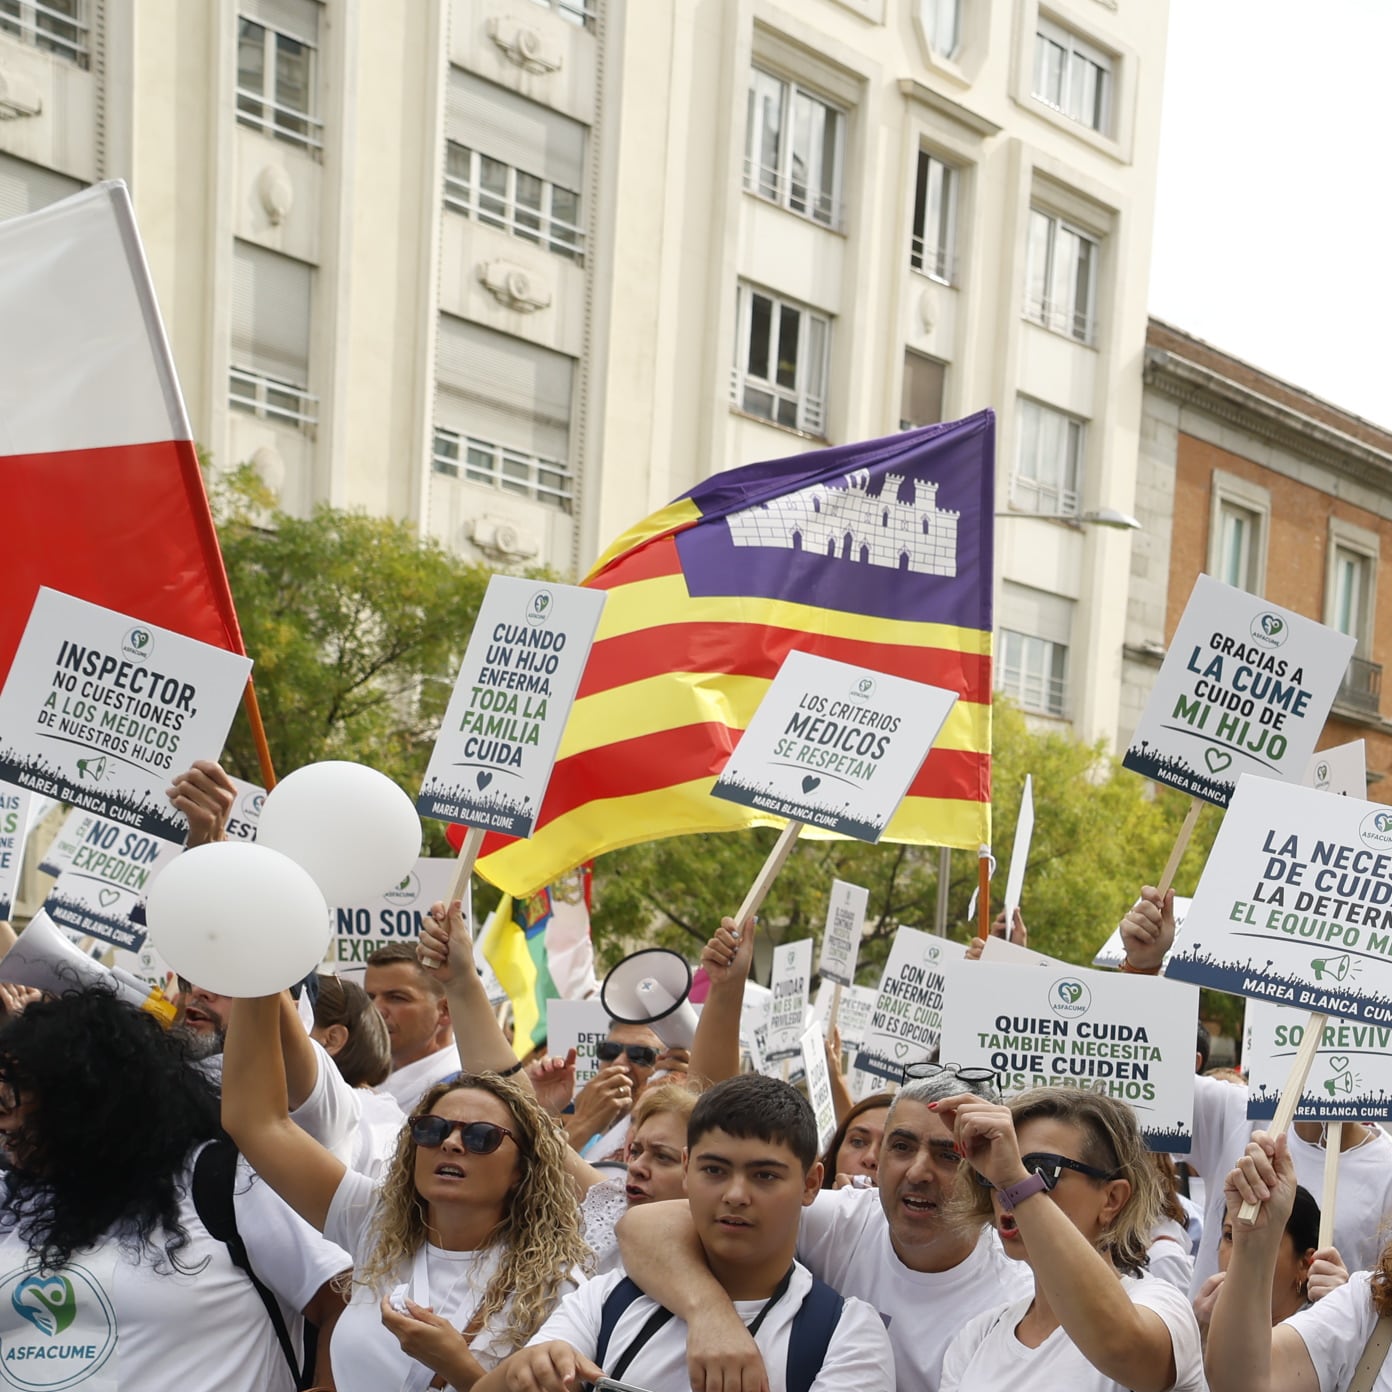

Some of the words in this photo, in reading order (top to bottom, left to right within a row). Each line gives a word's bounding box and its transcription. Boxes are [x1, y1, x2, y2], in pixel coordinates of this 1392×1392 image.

[493, 623, 566, 652] CUANDO
[486, 645, 510, 667] UN
[515, 650, 559, 674] HIJO
[1210, 632, 1289, 677] GRACIAS
[1290, 668, 1304, 686] A
[56, 640, 197, 718] INSPECTOR,
[478, 667, 551, 698] ENFERMA,
[1187, 646, 1224, 683] LA
[1231, 665, 1312, 718] CUME
[52, 671, 77, 692] NO
[81, 681, 184, 730] CUESTIONES
[468, 687, 518, 715] TODA
[523, 696, 547, 721] LA
[800, 693, 828, 712] LOS
[829, 701, 901, 732] CRITERIOS
[1194, 679, 1256, 717] CUIDO
[1259, 706, 1287, 731] DE
[38, 710, 57, 728] DE
[59, 717, 129, 754] NUESTROS
[132, 746, 173, 769] HIJOS
[45, 692, 57, 708] A
[62, 697, 97, 722] LOS
[100, 713, 180, 752] MÉDICOS
[460, 711, 540, 746] FAMILIA
[784, 712, 890, 760] MÉDICOS
[1172, 694, 1210, 729] MI
[1215, 712, 1288, 760] HIJO
[464, 737, 523, 767] CUIDA
[773, 739, 797, 758] SE
[799, 745, 876, 781] RESPETAN
[18, 771, 58, 796] MAREA
[61, 786, 106, 813] BLANCA
[1262, 830, 1298, 859] LA
[1263, 857, 1307, 886] DE
[1253, 883, 1285, 907] LA
[1229, 901, 1258, 925] EL
[1266, 910, 1361, 947] EQUIPO
[1053, 1004, 1086, 1012] ASFACUME
[1242, 978, 1295, 1001] MAREA
[1299, 991, 1359, 1015] BLANCA
[977, 1033, 1067, 1055] TAMBIÉN
[1071, 1041, 1162, 1062] NECESITA
[995, 1016, 1069, 1036] QUIEN
[1077, 1023, 1149, 1043] CUIDA
[991, 1053, 1043, 1074] QUE
[1051, 1057, 1149, 1081] CUIDEN
[6, 1345, 96, 1360] ASFACUME
